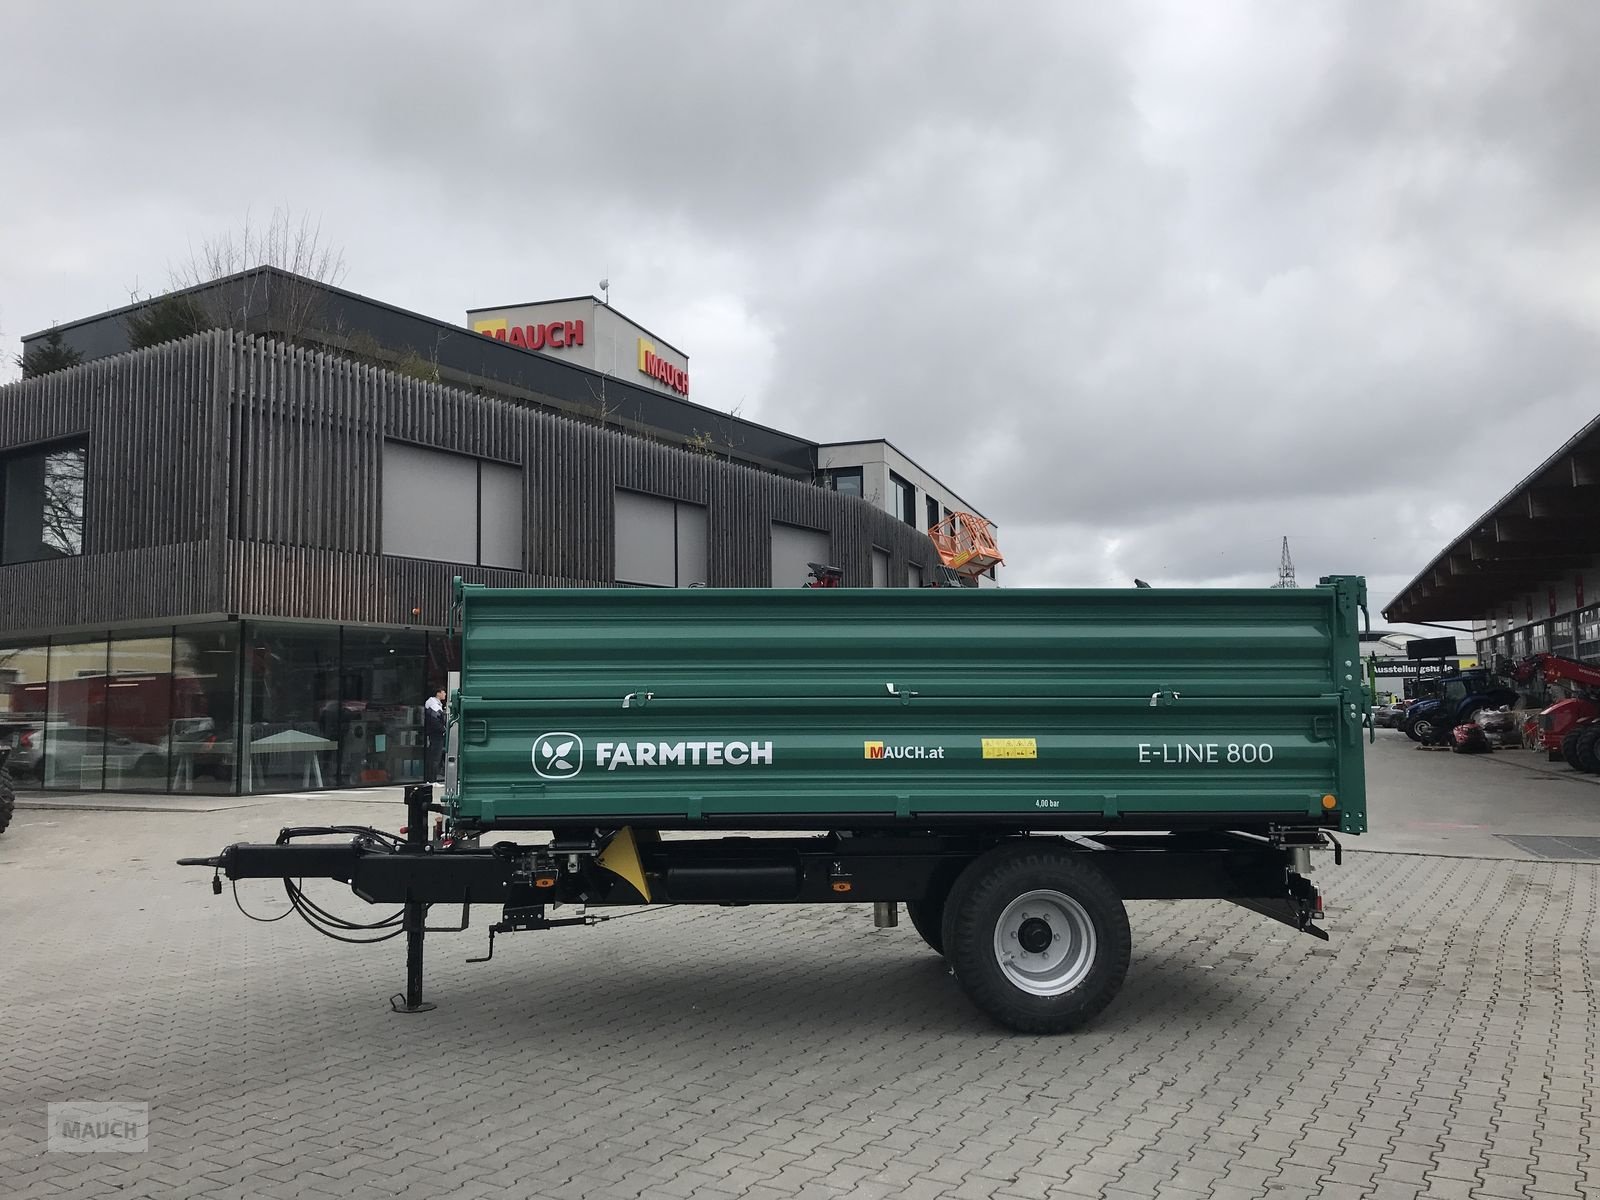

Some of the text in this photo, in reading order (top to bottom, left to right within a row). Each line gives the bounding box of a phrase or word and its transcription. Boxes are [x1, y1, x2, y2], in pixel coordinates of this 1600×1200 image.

[644, 350, 689, 396] MAUCH
[596, 741, 773, 771] FARMTECH
[869, 746, 945, 759] MAUCH.at
[1138, 743, 1274, 763] E-LINE 800
[1035, 799, 1060, 808] 4,00 bar
